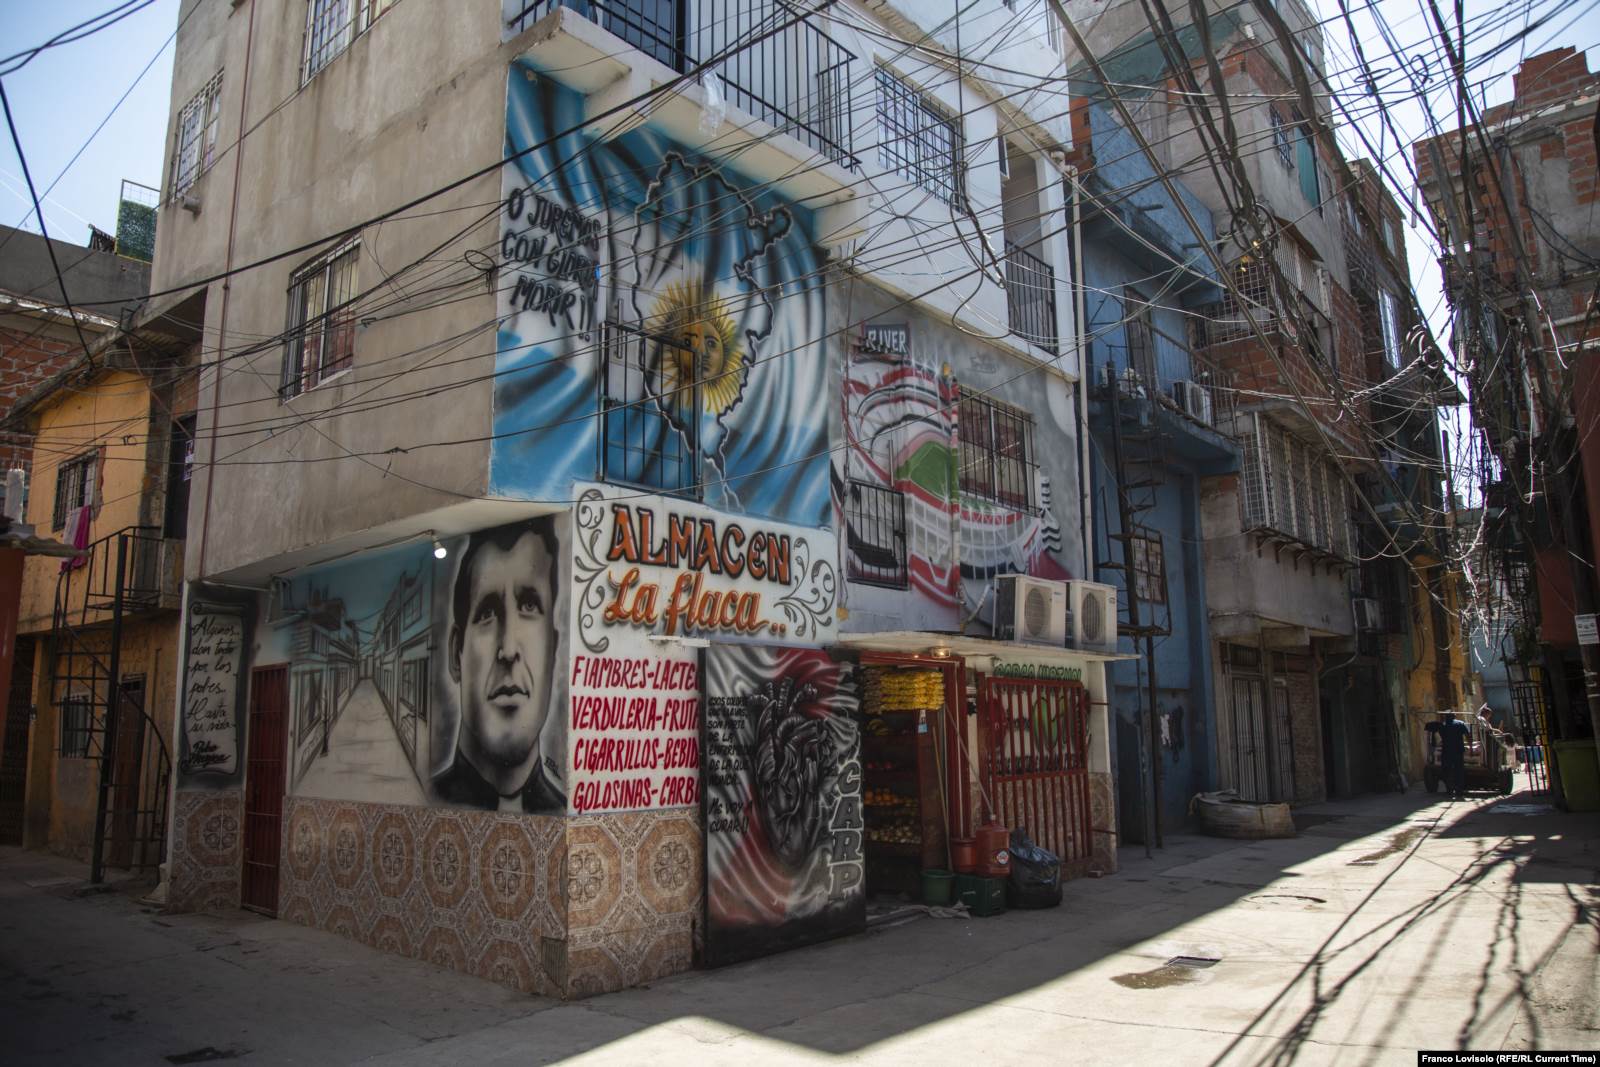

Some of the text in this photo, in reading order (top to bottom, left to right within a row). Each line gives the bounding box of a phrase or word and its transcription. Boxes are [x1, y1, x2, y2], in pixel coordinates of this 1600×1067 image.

[508, 187, 525, 221] O
[502, 229, 548, 268] CON
[864, 327, 908, 354] RIVER
[606, 503, 792, 586] ALMACEN
[603, 567, 660, 625] La
[571, 655, 699, 691] FIAMBRES-LACTE
